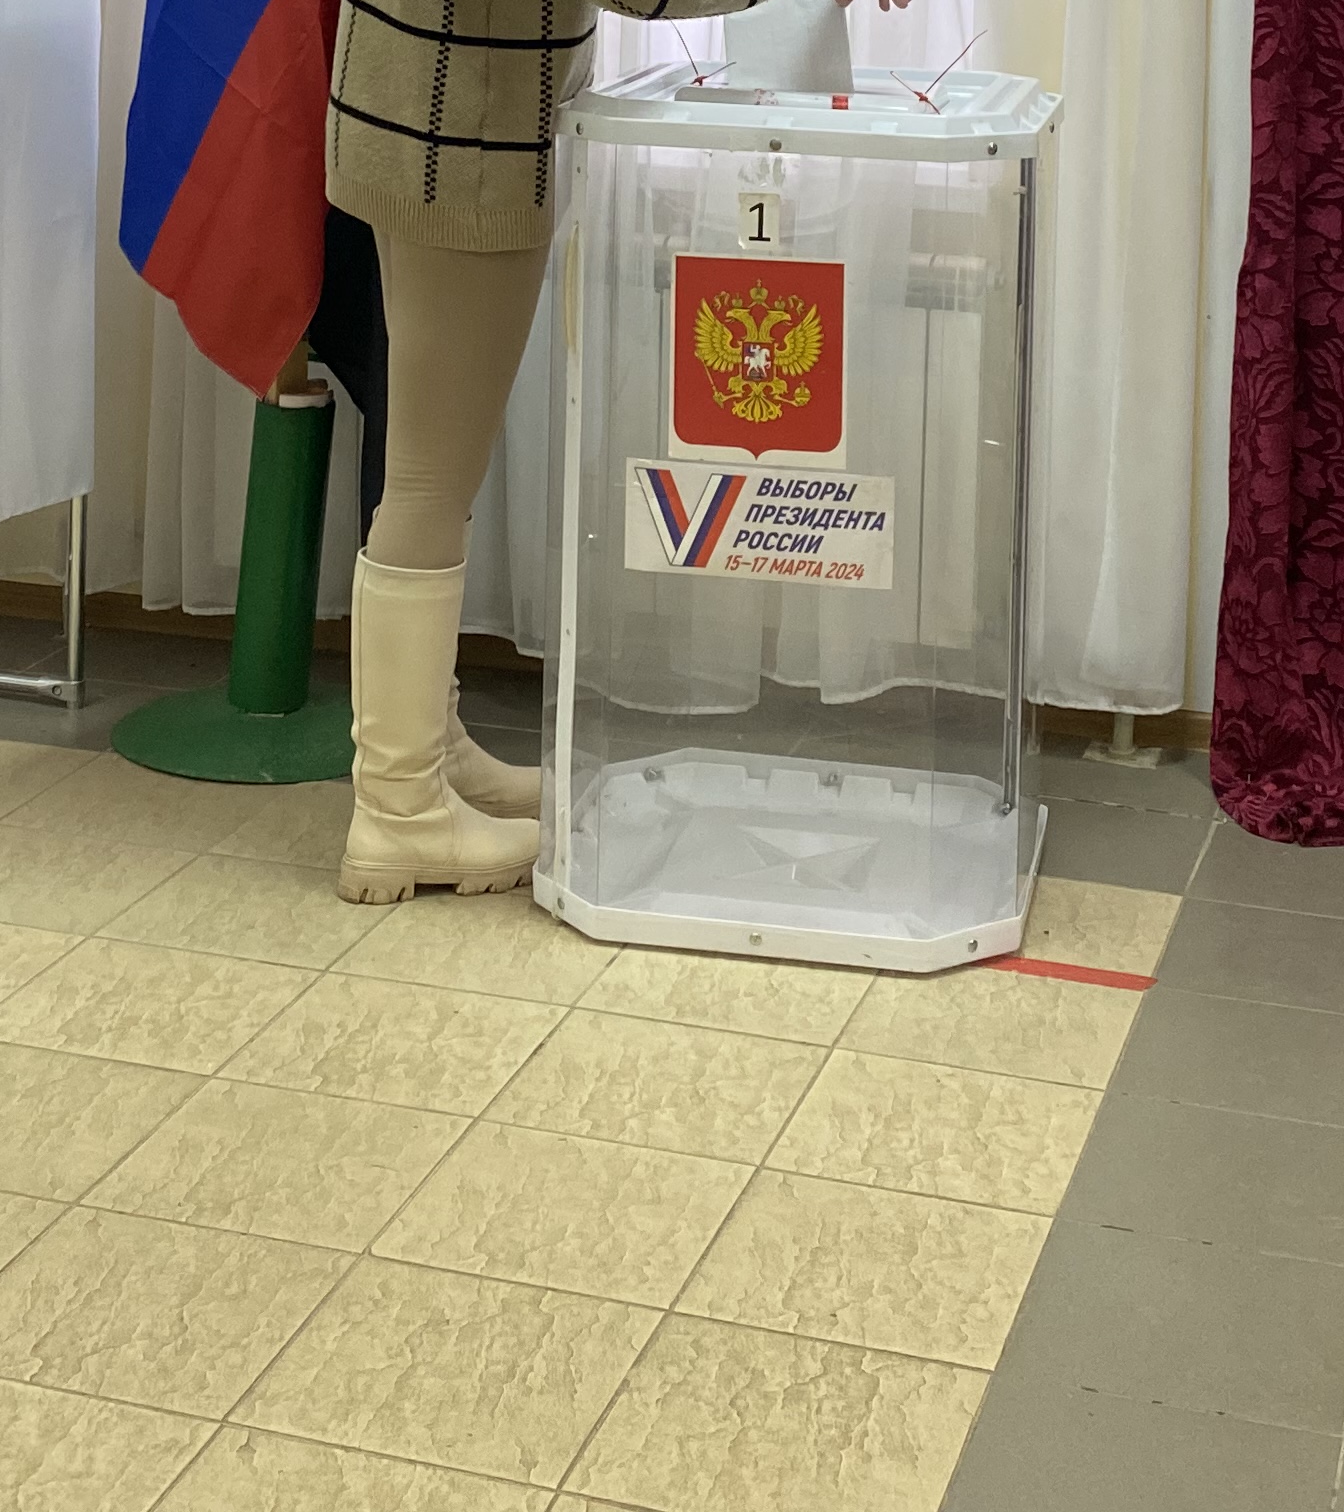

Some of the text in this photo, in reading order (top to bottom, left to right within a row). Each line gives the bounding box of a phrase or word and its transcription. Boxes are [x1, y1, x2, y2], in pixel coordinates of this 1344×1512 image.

[747, 202, 771, 242] 1
[756, 477, 858, 502] ВЫБОРЫ
[744, 503, 887, 531] ПРЕЗИДЕНТА
[732, 529, 824, 554] РОССИИ
[768, 558, 822, 579] МАРТА
[824, 562, 865, 581] 2024
